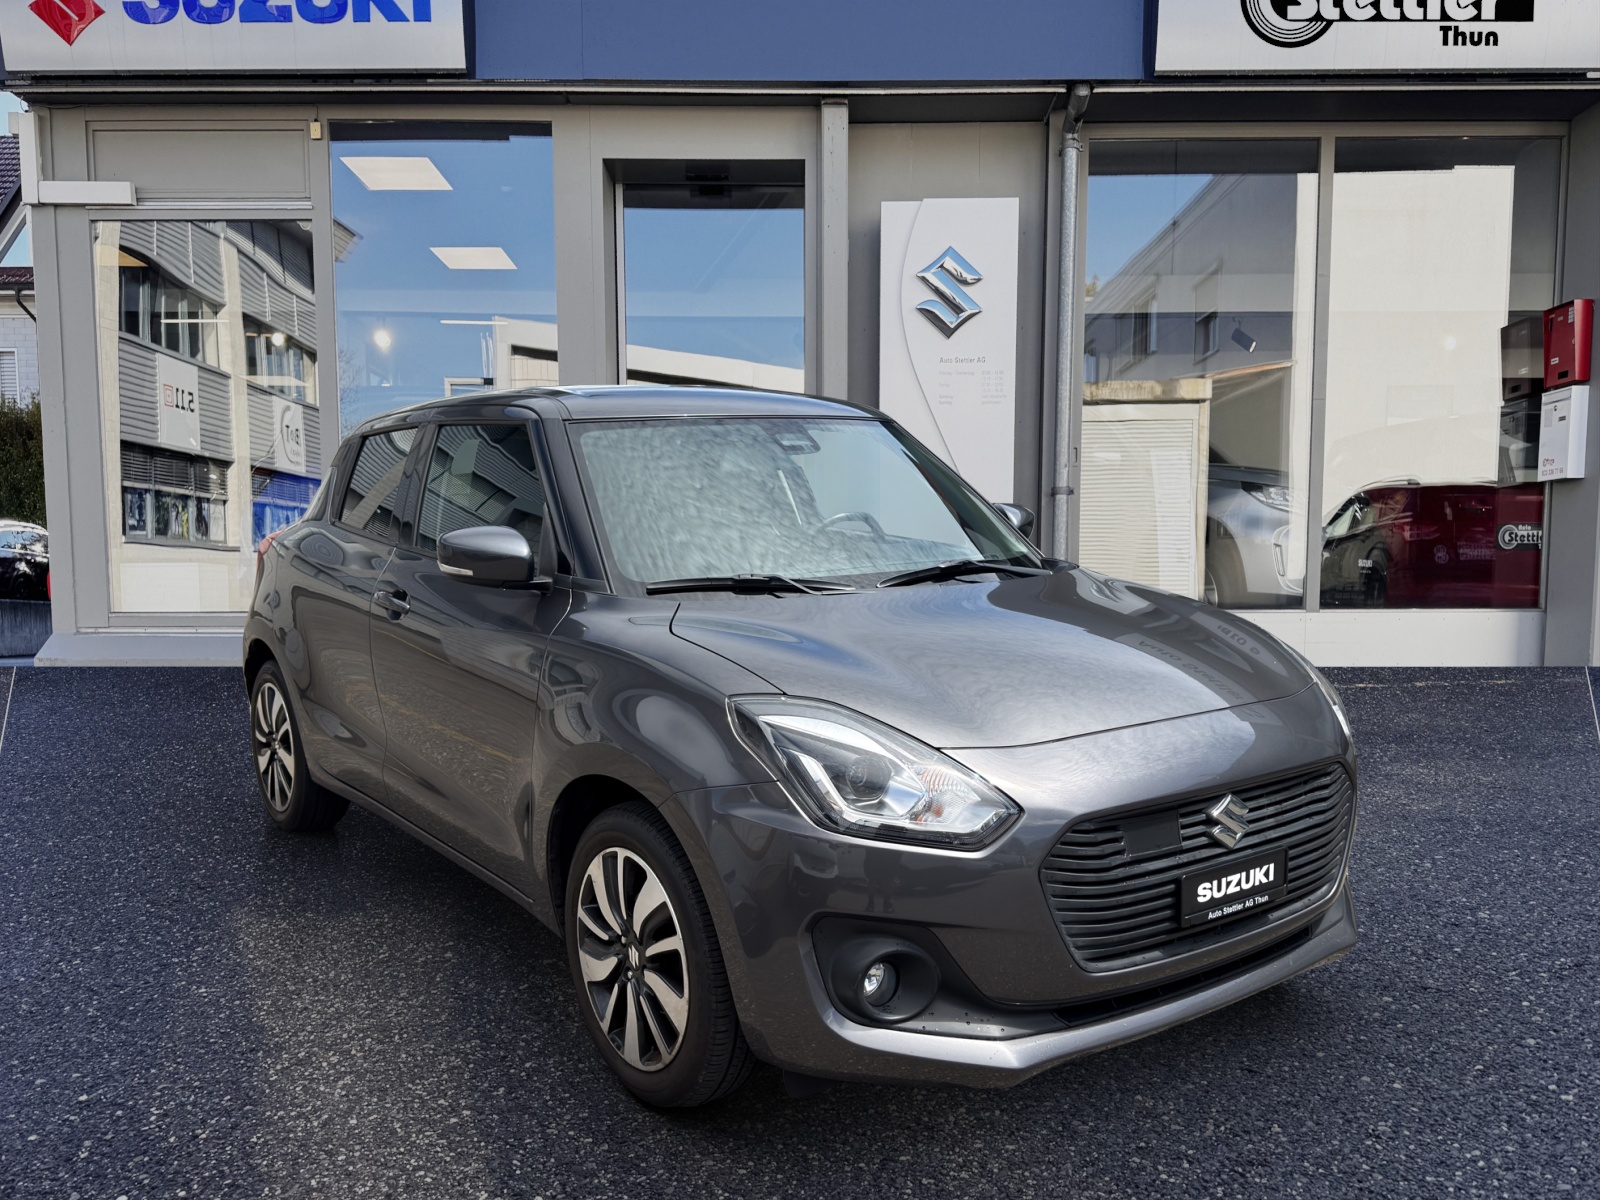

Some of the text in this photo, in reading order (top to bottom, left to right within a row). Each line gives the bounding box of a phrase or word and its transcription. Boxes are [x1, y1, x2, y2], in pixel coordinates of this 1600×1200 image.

[1439, 25, 1499, 47] Thun
[939, 356, 986, 364] Auto Stettler AG
[1197, 863, 1275, 903] SUZUKI
[1208, 895, 1269, 920] Auto Stettler AG Thun
